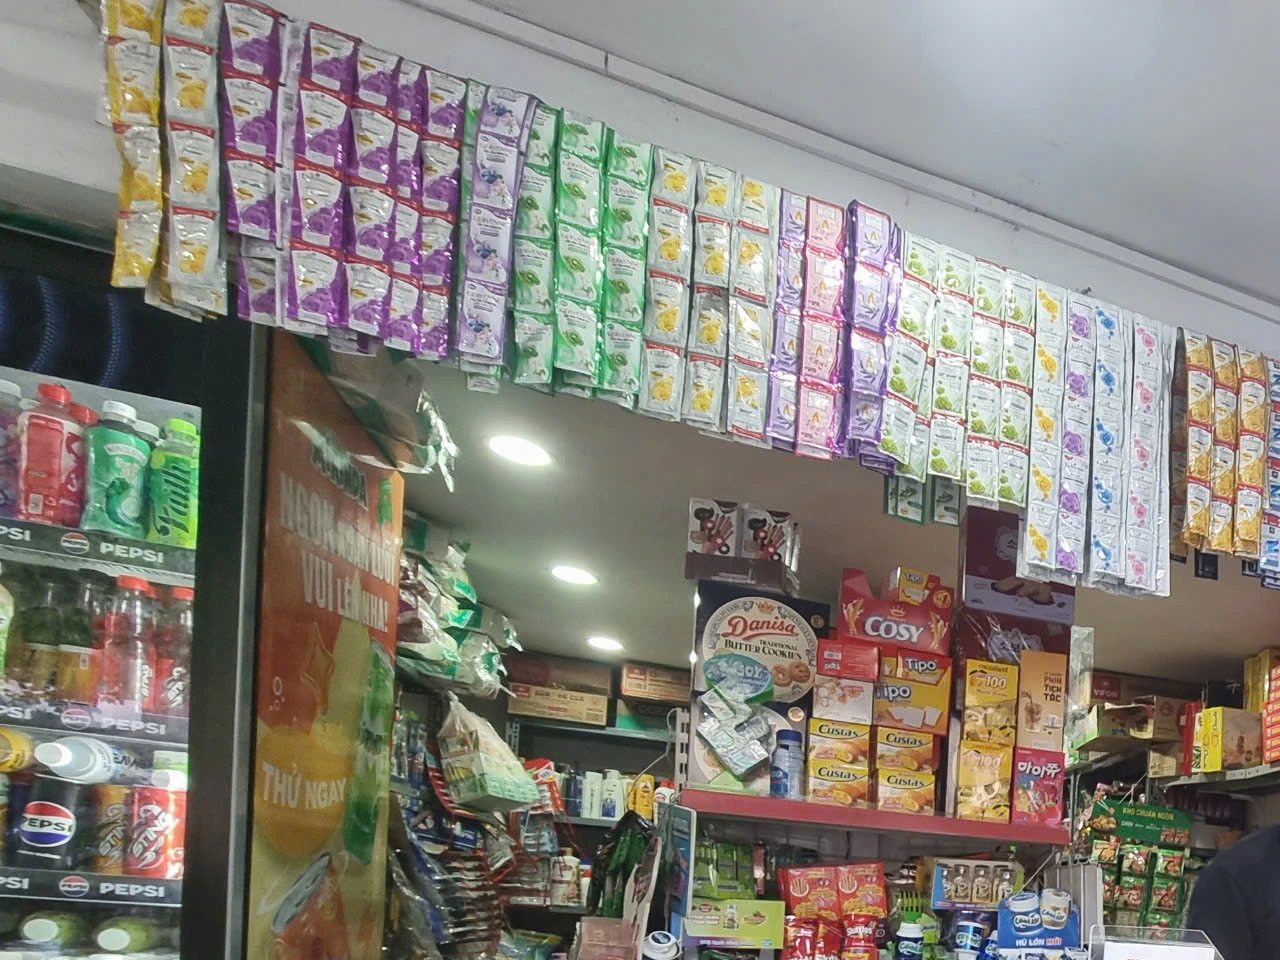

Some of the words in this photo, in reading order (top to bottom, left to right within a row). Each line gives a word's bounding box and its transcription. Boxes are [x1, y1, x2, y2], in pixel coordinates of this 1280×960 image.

[100, 542, 163, 562] PEPSI
[721, 615, 799, 641] Danisa
[864, 616, 924, 643] COSY
[725, 639, 760, 653] BUTTER
[761, 647, 802, 661] COOKIES
[904, 657, 938, 674] Tipo
[101, 717, 166, 735] PEPSI
[818, 724, 860, 740] Custas
[885, 733, 924, 748] Custas
[817, 766, 858, 781] Custas
[886, 774, 925, 789] Custas
[100, 883, 165, 898] PEPSI
[1029, 936, 1045, 946] LỚN
